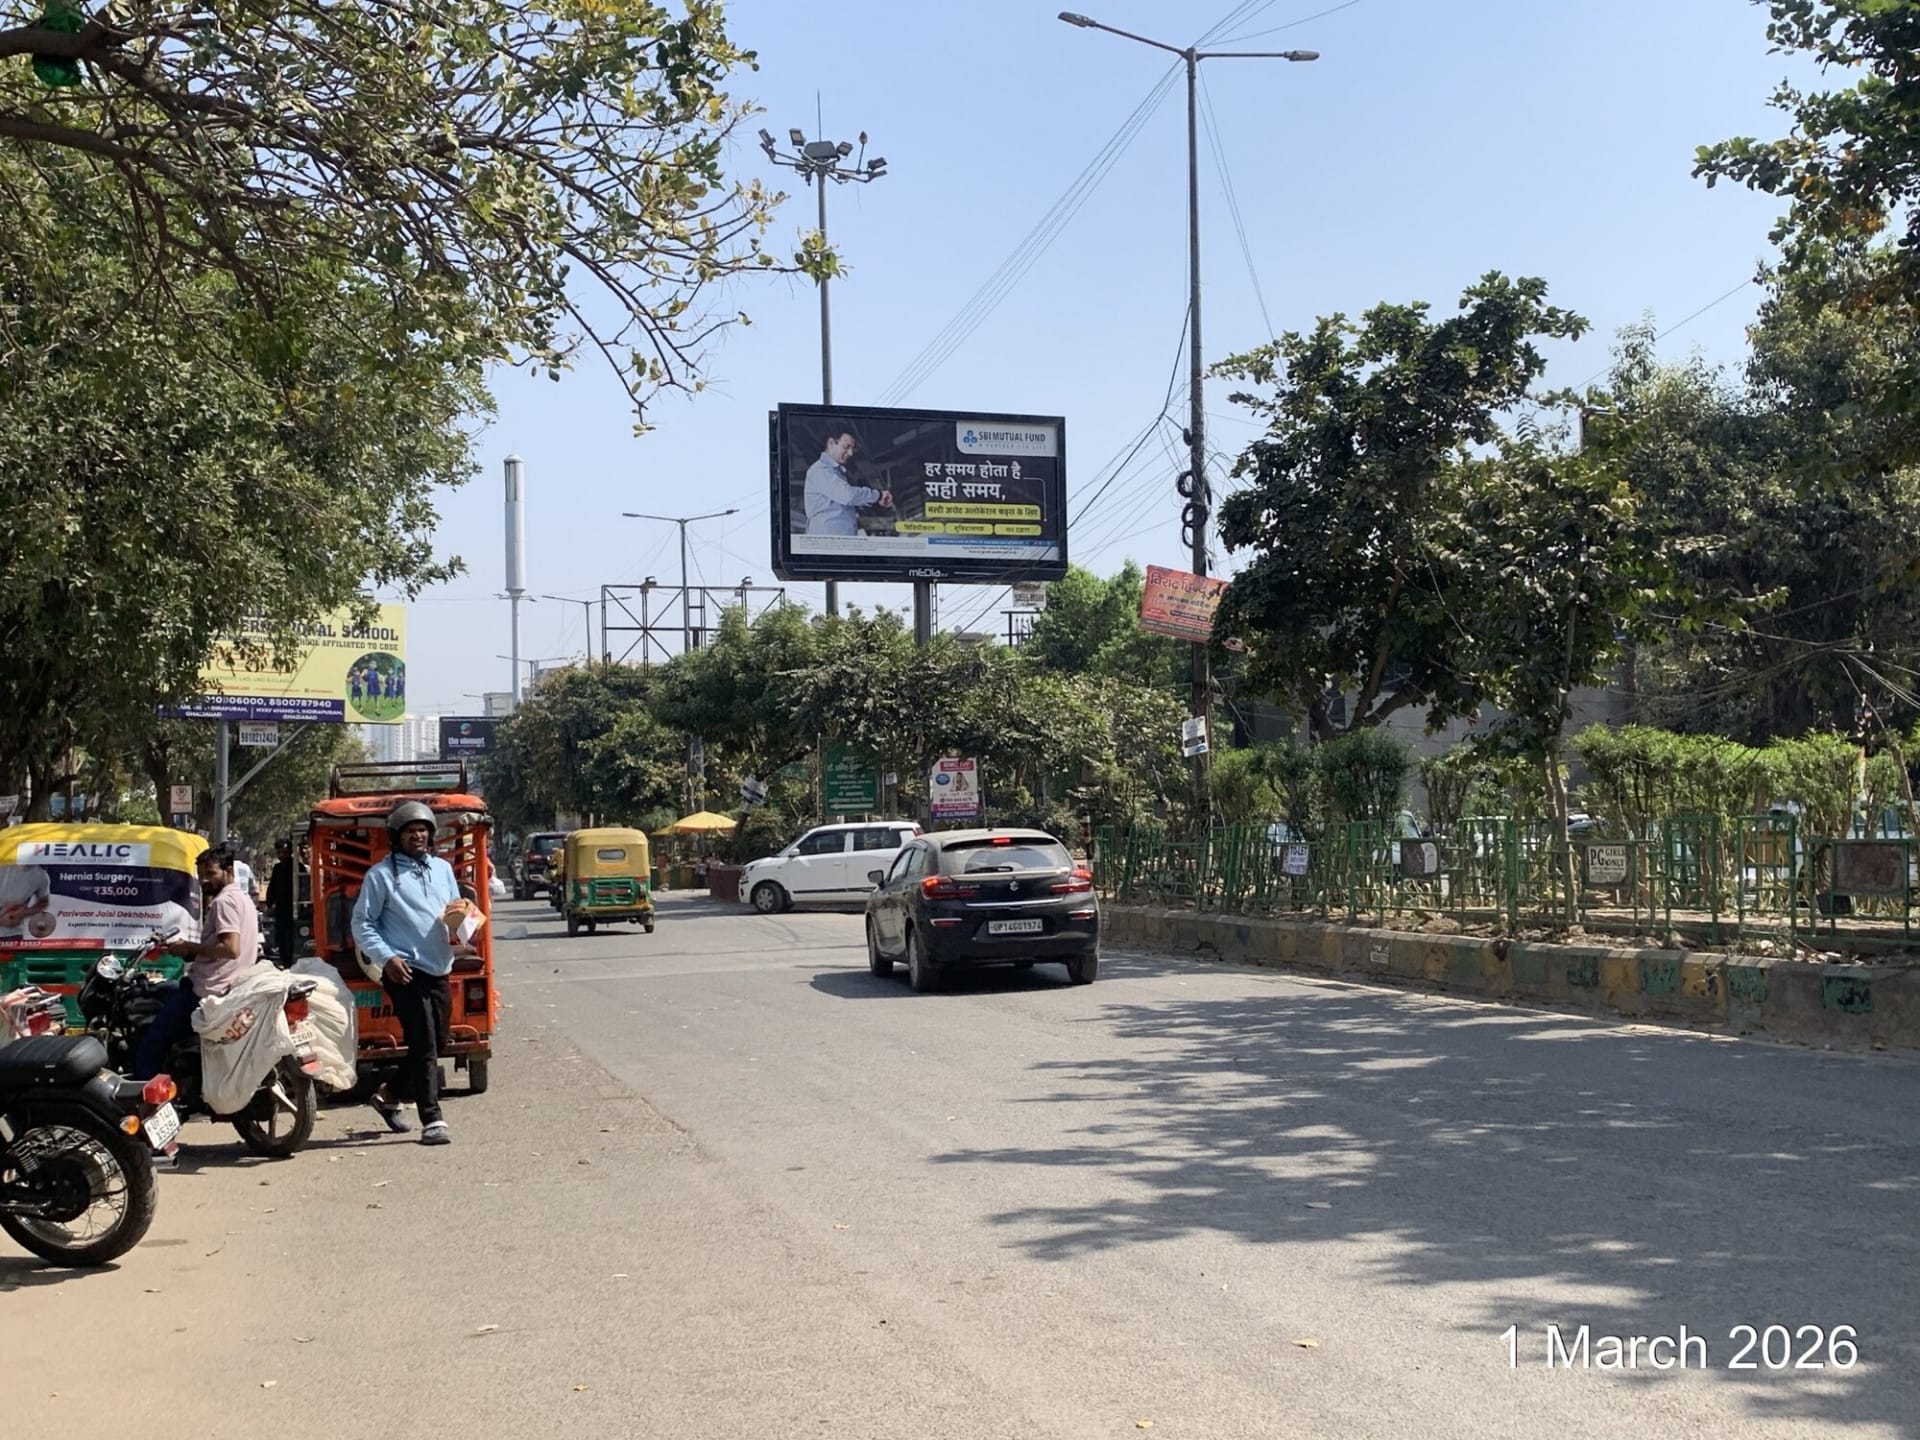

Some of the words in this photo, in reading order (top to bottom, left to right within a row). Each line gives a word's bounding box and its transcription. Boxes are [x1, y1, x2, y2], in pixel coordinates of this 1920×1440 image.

[978, 431, 992, 441] SBI
[993, 431, 1023, 442] MUTUAL
[1024, 432, 1046, 443] FUND
[924, 462, 942, 477] हर
[944, 463, 976, 477] समय
[978, 459, 1009, 478] होता
[1011, 461, 1022, 480] है
[924, 477, 958, 499] सही
[961, 483, 1006, 501] समय,
[322, 640, 366, 650] AFFILIATED
[33, 844, 132, 857] HEALIC
[1605, 847, 1625, 857] GIRLS
[59, 872, 93, 881] Hernia
[94, 872, 134, 884] Surgery
